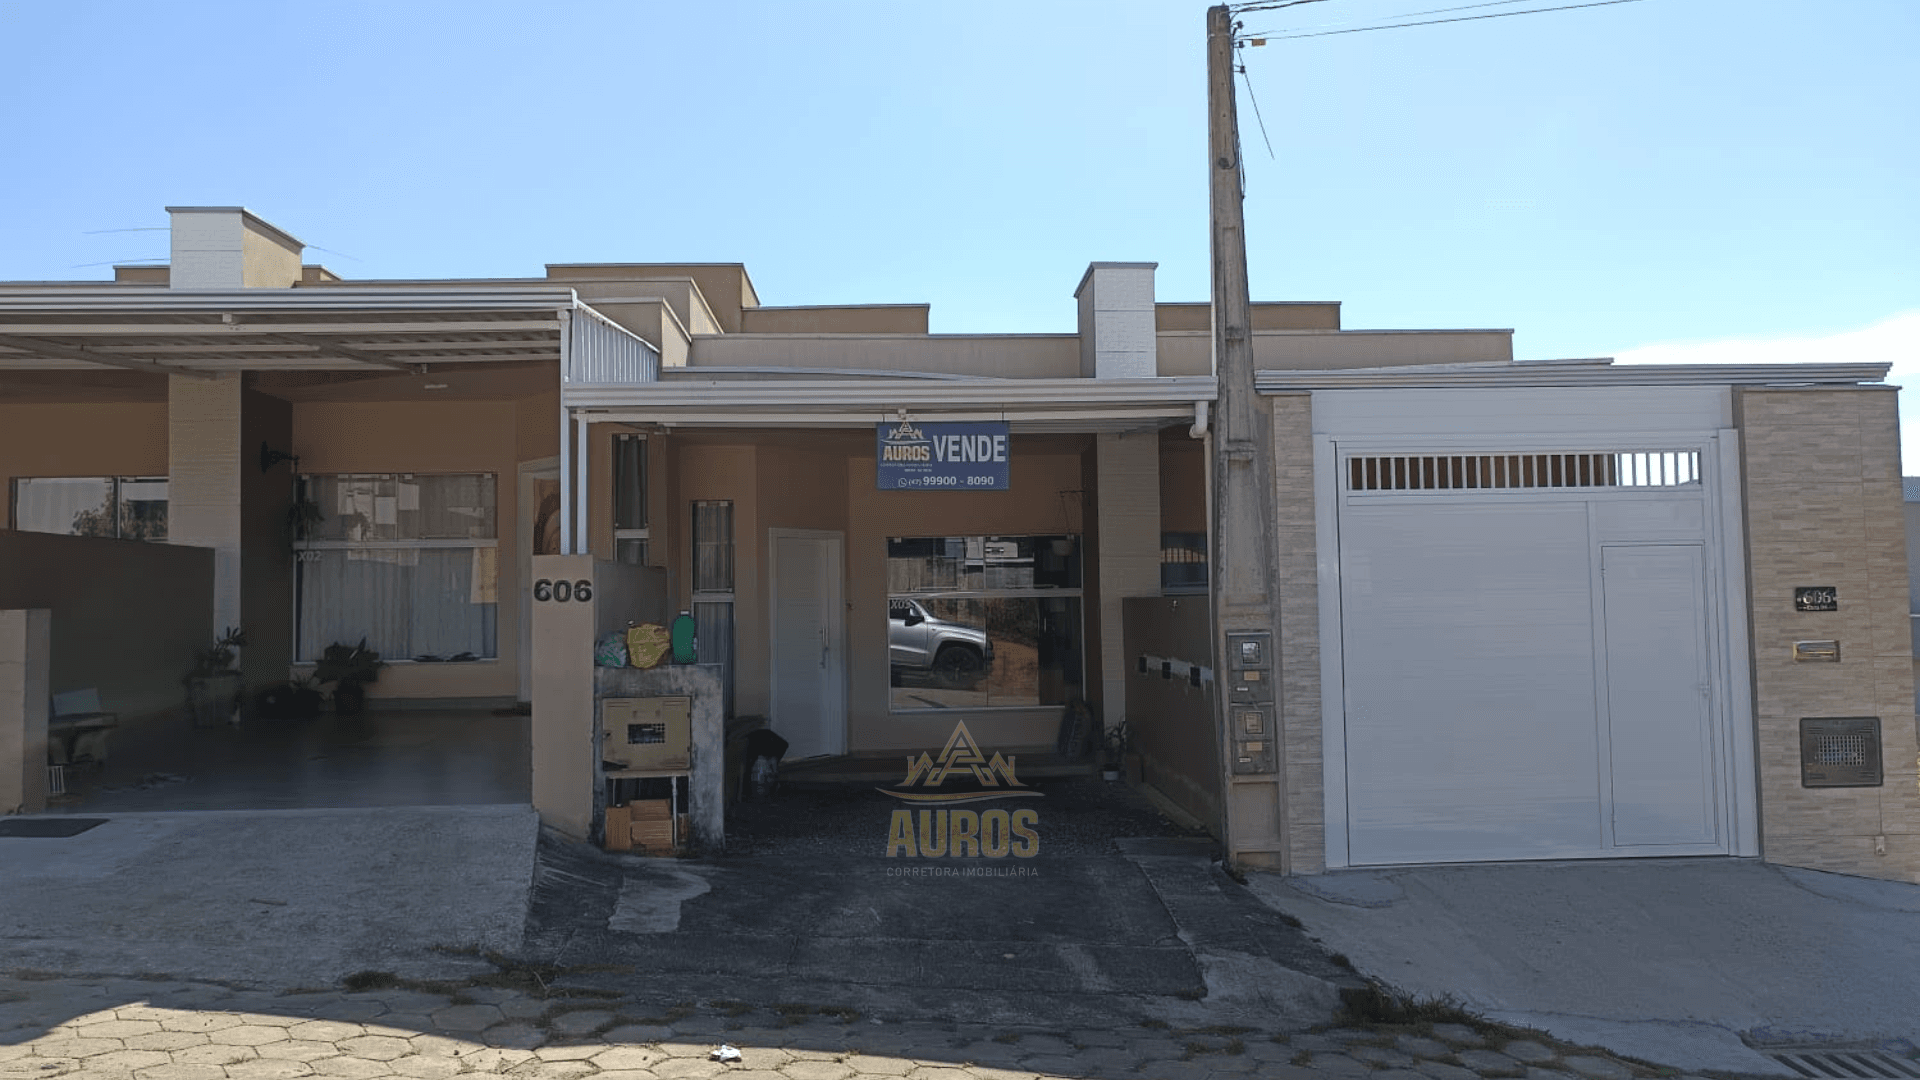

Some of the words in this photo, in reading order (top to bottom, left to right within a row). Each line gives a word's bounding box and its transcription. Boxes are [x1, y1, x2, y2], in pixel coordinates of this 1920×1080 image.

[882, 445, 930, 461] AUROS
[932, 435, 1006, 462] VENDE
[923, 476, 957, 486] 99900
[967, 476, 994, 486] 8090
[533, 579, 593, 603] 606
[1803, 591, 1832, 604] 606
